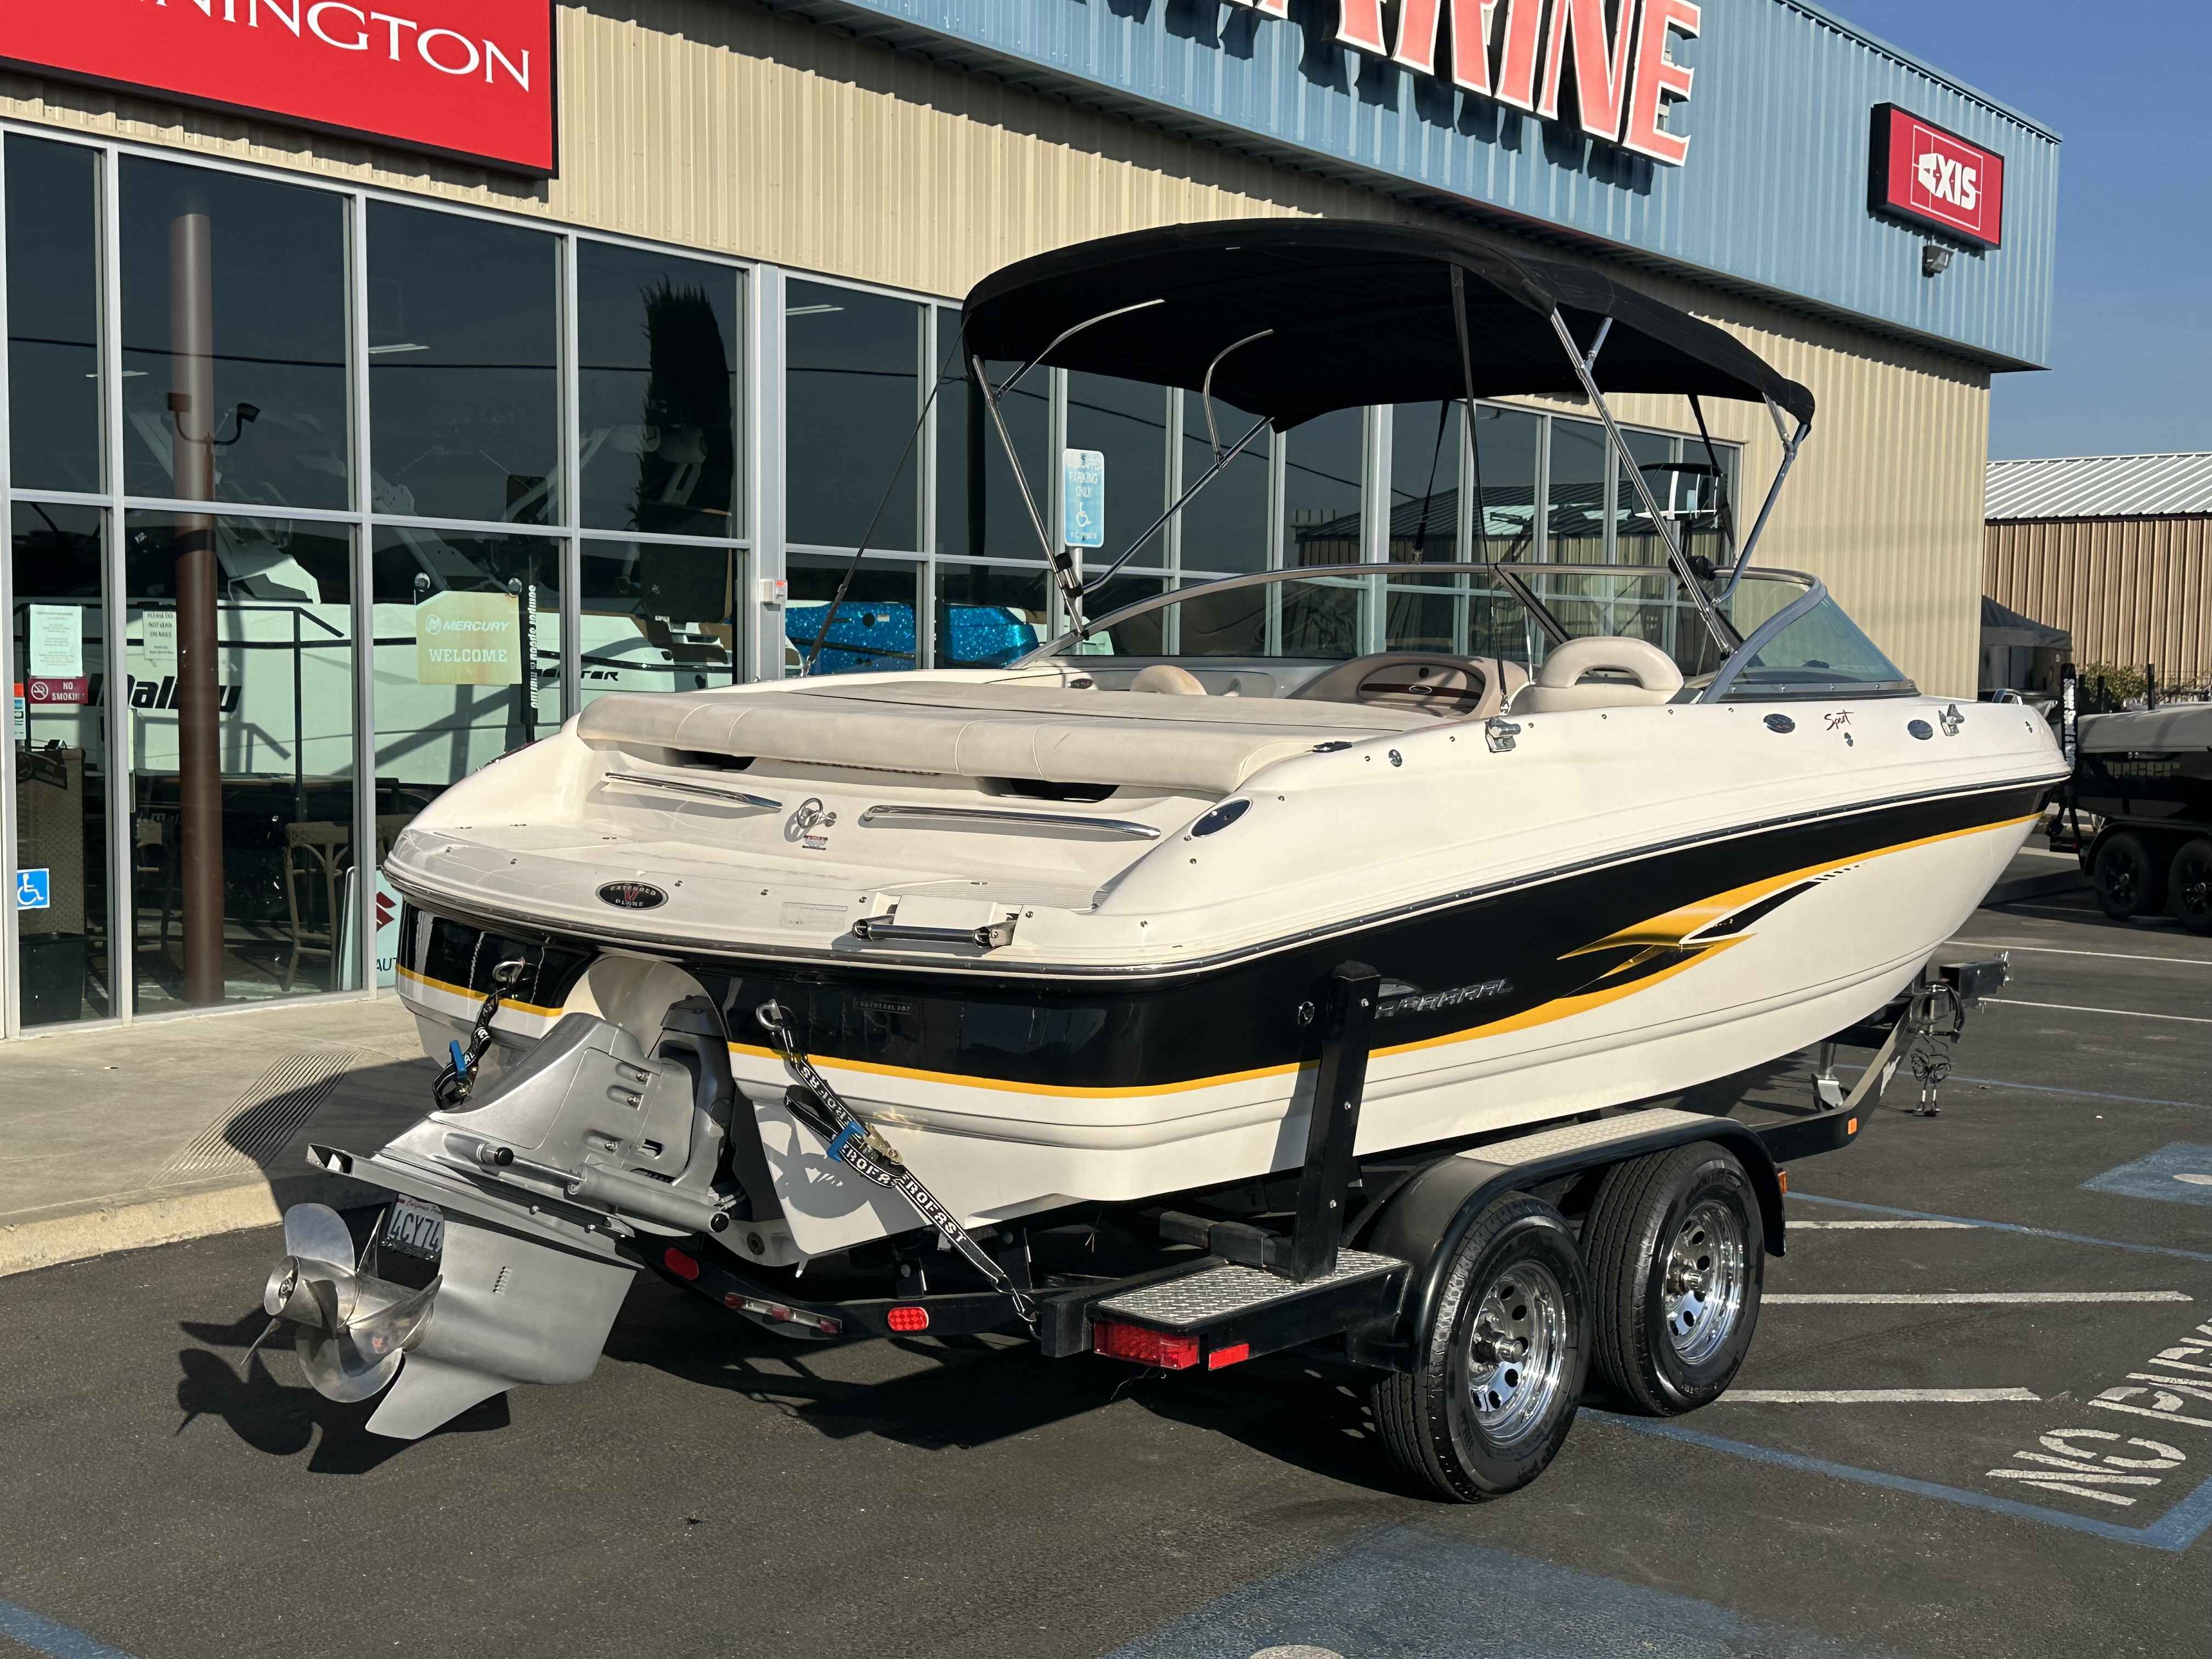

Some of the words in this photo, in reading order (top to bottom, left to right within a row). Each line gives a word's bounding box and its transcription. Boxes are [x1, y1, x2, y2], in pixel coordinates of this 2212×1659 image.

[1918, 153, 1977, 211] AXIS
[1069, 471, 1098, 484] PARKING
[1075, 486, 1093, 498] ONLY
[443, 619, 510, 631] MERCURY
[428, 648, 508, 662] WELCOME
[63, 681, 74, 690] NO
[390, 1209, 441, 1251] 4CY74
[1985, 1428, 2187, 1506] NO
